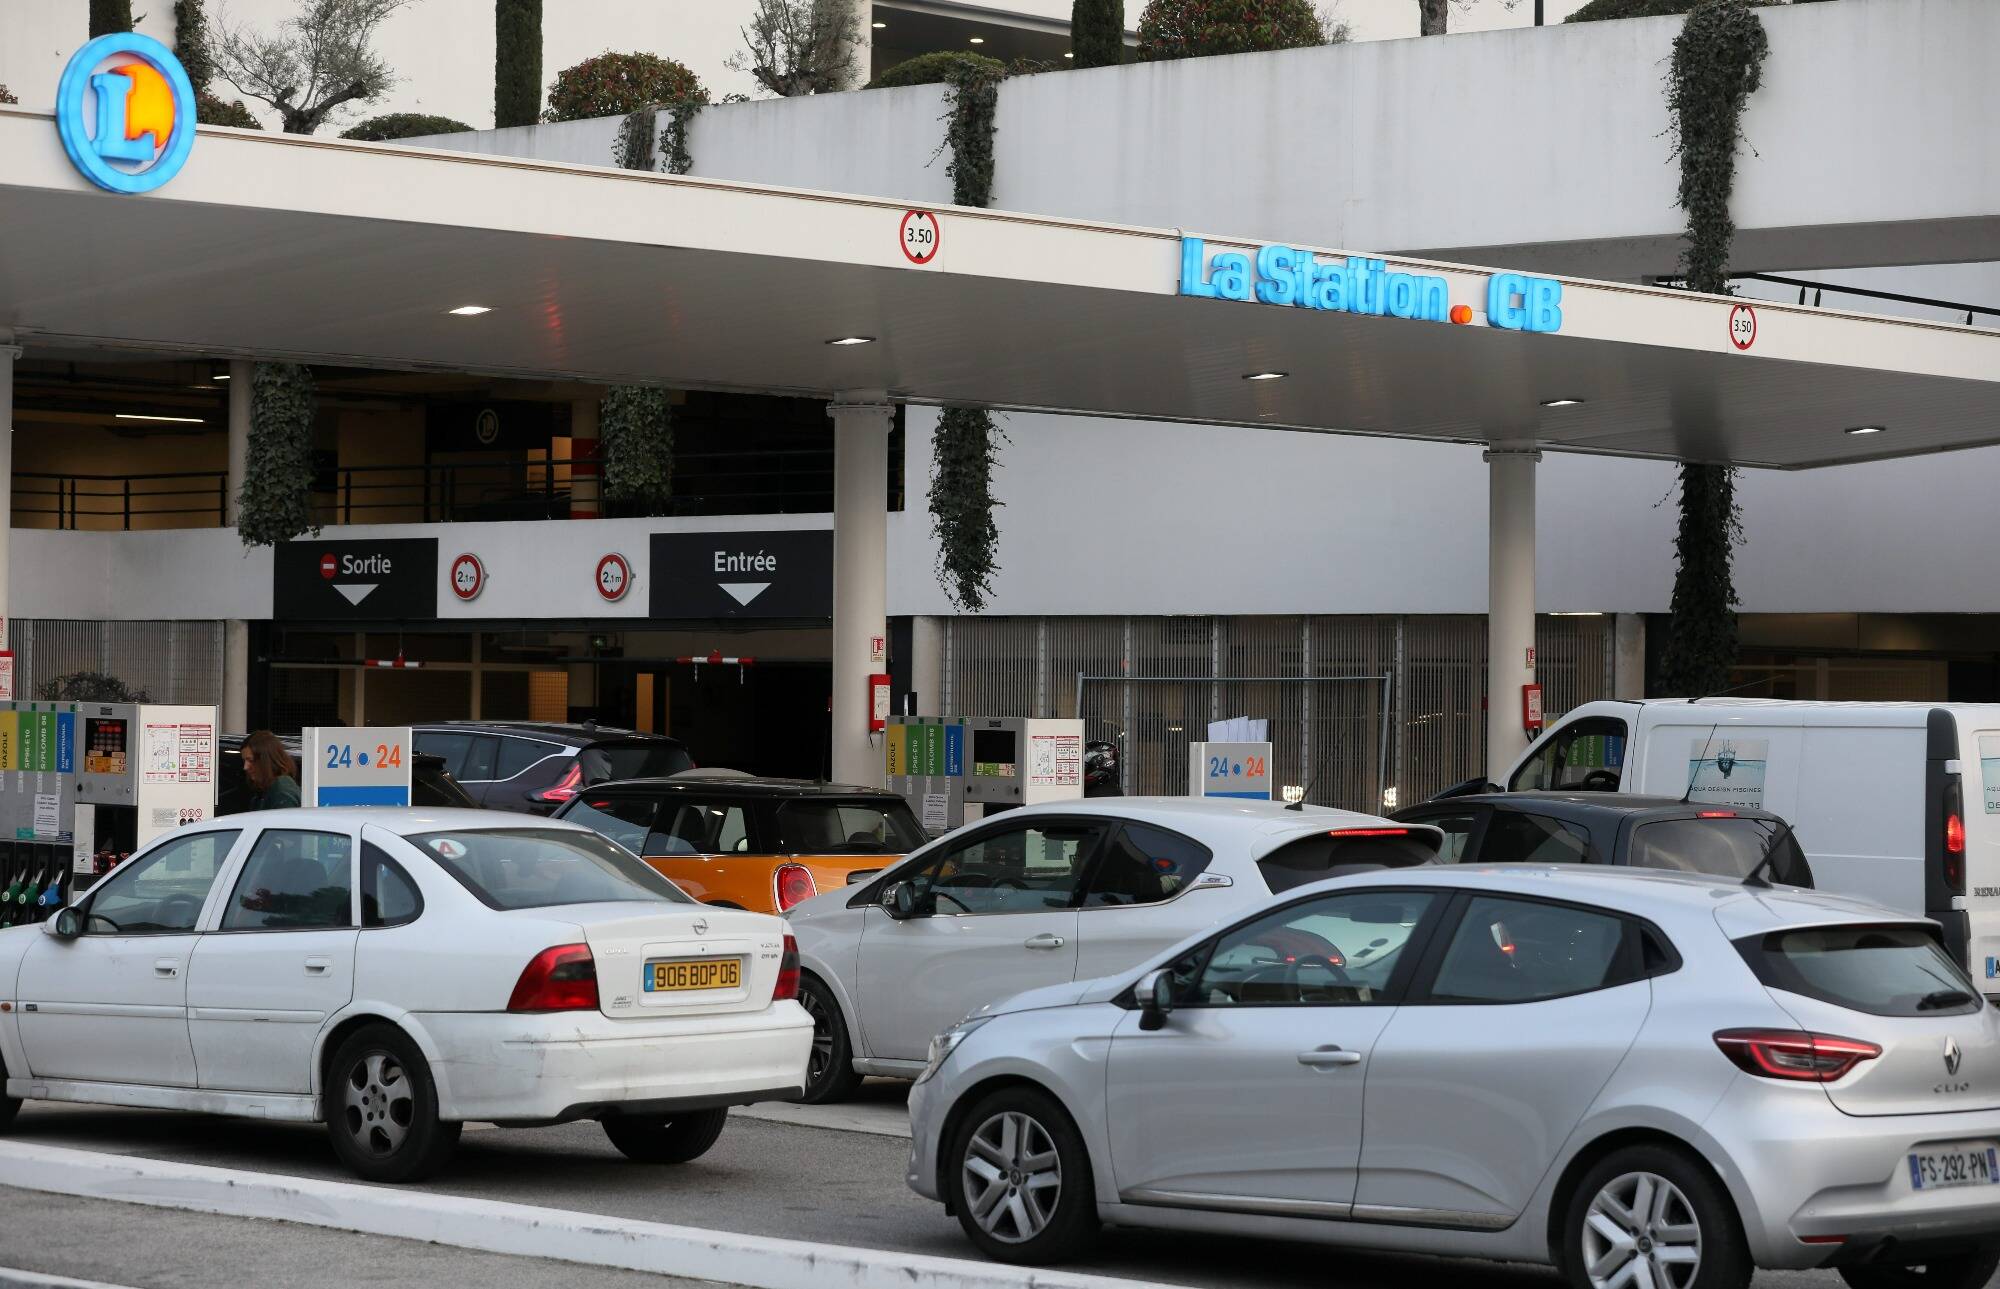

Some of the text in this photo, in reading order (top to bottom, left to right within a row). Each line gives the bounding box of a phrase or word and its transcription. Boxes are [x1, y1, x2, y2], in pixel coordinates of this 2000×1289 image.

[907, 227, 932, 244] 3.50
[1180, 237, 1251, 301] La
[1486, 272, 1562, 333] CB
[1734, 319, 1752, 333] 3.50
[342, 553, 392, 575] Sortie
[714, 549, 777, 572] Entrée
[327, 744, 401, 769] 24 24
[1210, 756, 1265, 777] 24 24
[656, 963, 737, 988] 906 BDP 06
[1933, 1082, 1970, 1094] CLIO
